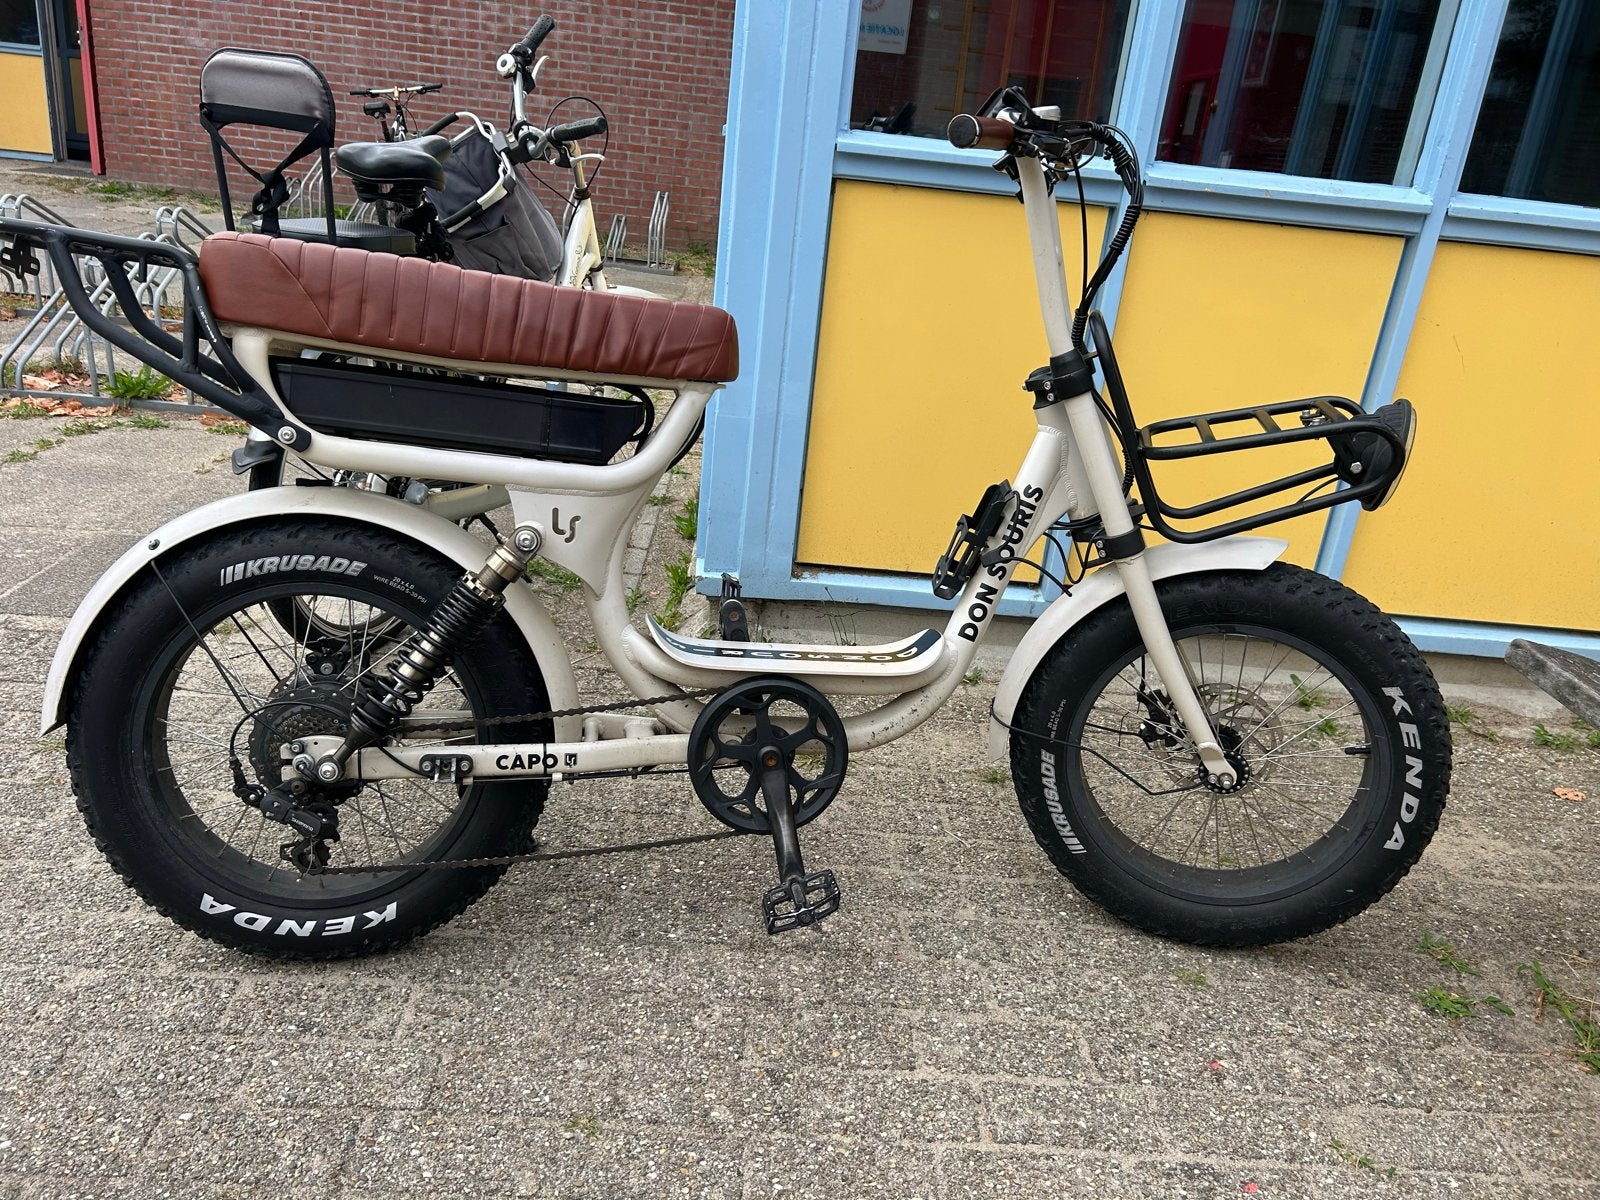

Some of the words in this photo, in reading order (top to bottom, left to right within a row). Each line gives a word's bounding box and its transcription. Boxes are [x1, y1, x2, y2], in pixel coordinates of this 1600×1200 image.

[244, 554, 368, 579] KRUSADE
[373, 574, 389, 585] WIRE
[389, 580, 406, 592] BEAD
[957, 582, 998, 643] DON
[987, 484, 1044, 581] SOURIS
[495, 753, 559, 770] CAPO
[1381, 686, 1424, 851] KENDA
[1040, 748, 1076, 838] KRUSADE
[199, 892, 398, 937] KENDA
